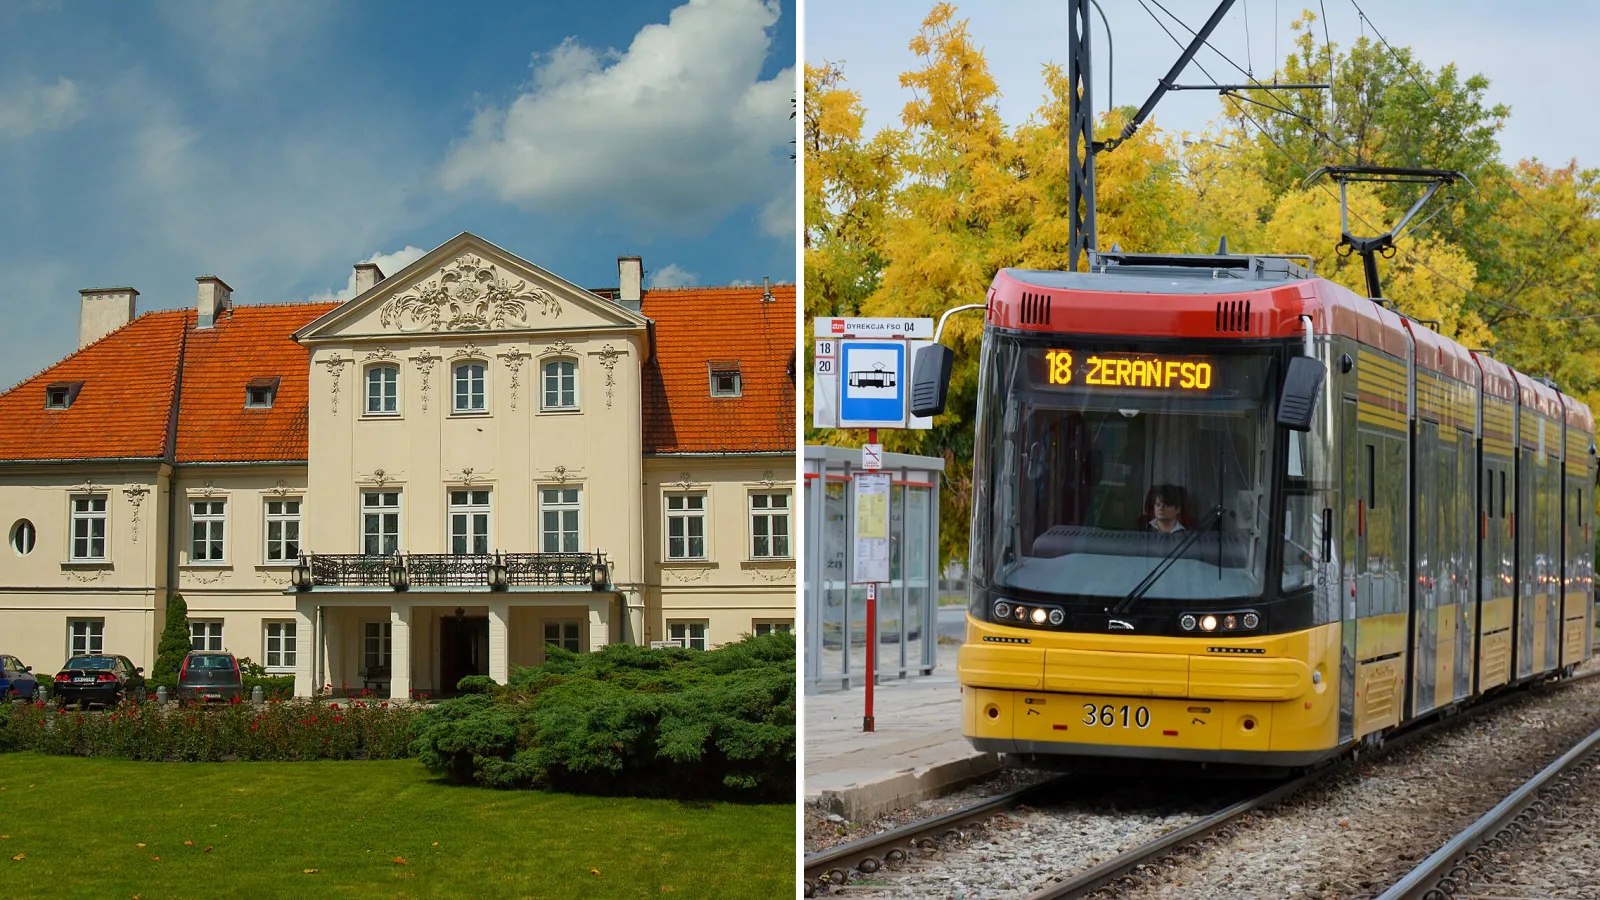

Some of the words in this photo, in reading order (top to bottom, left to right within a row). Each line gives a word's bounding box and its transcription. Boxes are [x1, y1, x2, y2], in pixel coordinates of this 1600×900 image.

[904, 322, 915, 332] 04
[819, 342, 831, 354] 18
[818, 360, 831, 372] 20
[1045, 351, 1073, 385] 18
[1085, 355, 1162, 387] ŻERAŃ
[1165, 361, 1212, 389] FSO
[1082, 703, 1151, 730] 3610
